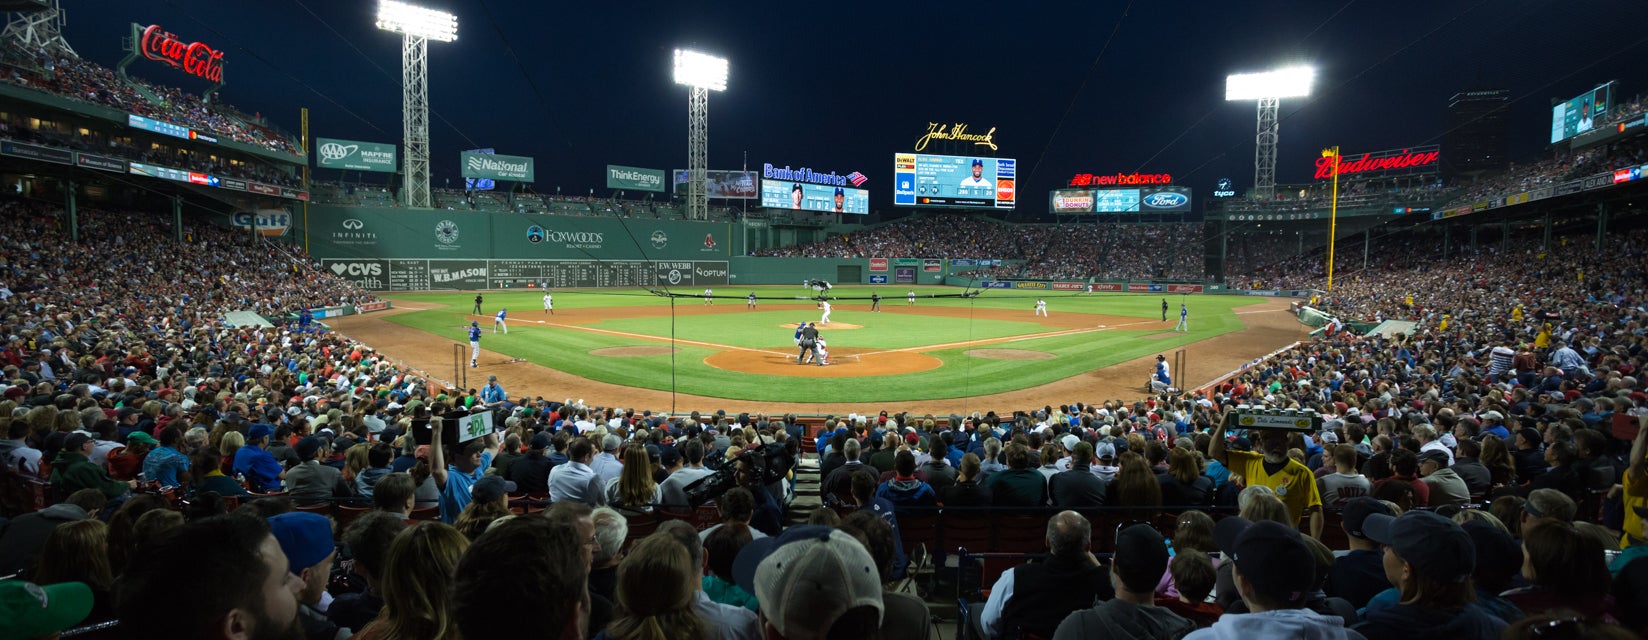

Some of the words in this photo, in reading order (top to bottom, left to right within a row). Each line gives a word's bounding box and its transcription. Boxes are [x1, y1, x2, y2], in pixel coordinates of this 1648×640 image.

[915, 121, 949, 152] John
[948, 123, 998, 151] Hancock
[324, 143, 345, 159] AAA
[361, 150, 393, 159] MAPFRE
[85, 158, 102, 166] Museum
[107, 161, 123, 169] Science
[482, 159, 528, 172] National
[1314, 148, 1440, 179] Budweiser
[764, 163, 793, 180] Bank
[793, 167, 805, 182] of
[805, 168, 847, 186] America
[1092, 175, 1118, 185] new
[1118, 171, 1171, 185] balance
[1150, 194, 1179, 207] Ford
[234, 211, 288, 227] Gulf
[333, 231, 376, 239] INFINITI
[546, 229, 603, 243] FOXWOODS
[347, 262, 382, 276] CVS
[672, 262, 692, 270] WEBB
[472, 418, 486, 437] IPA
[1337, 486, 1367, 498] ORTIZ
